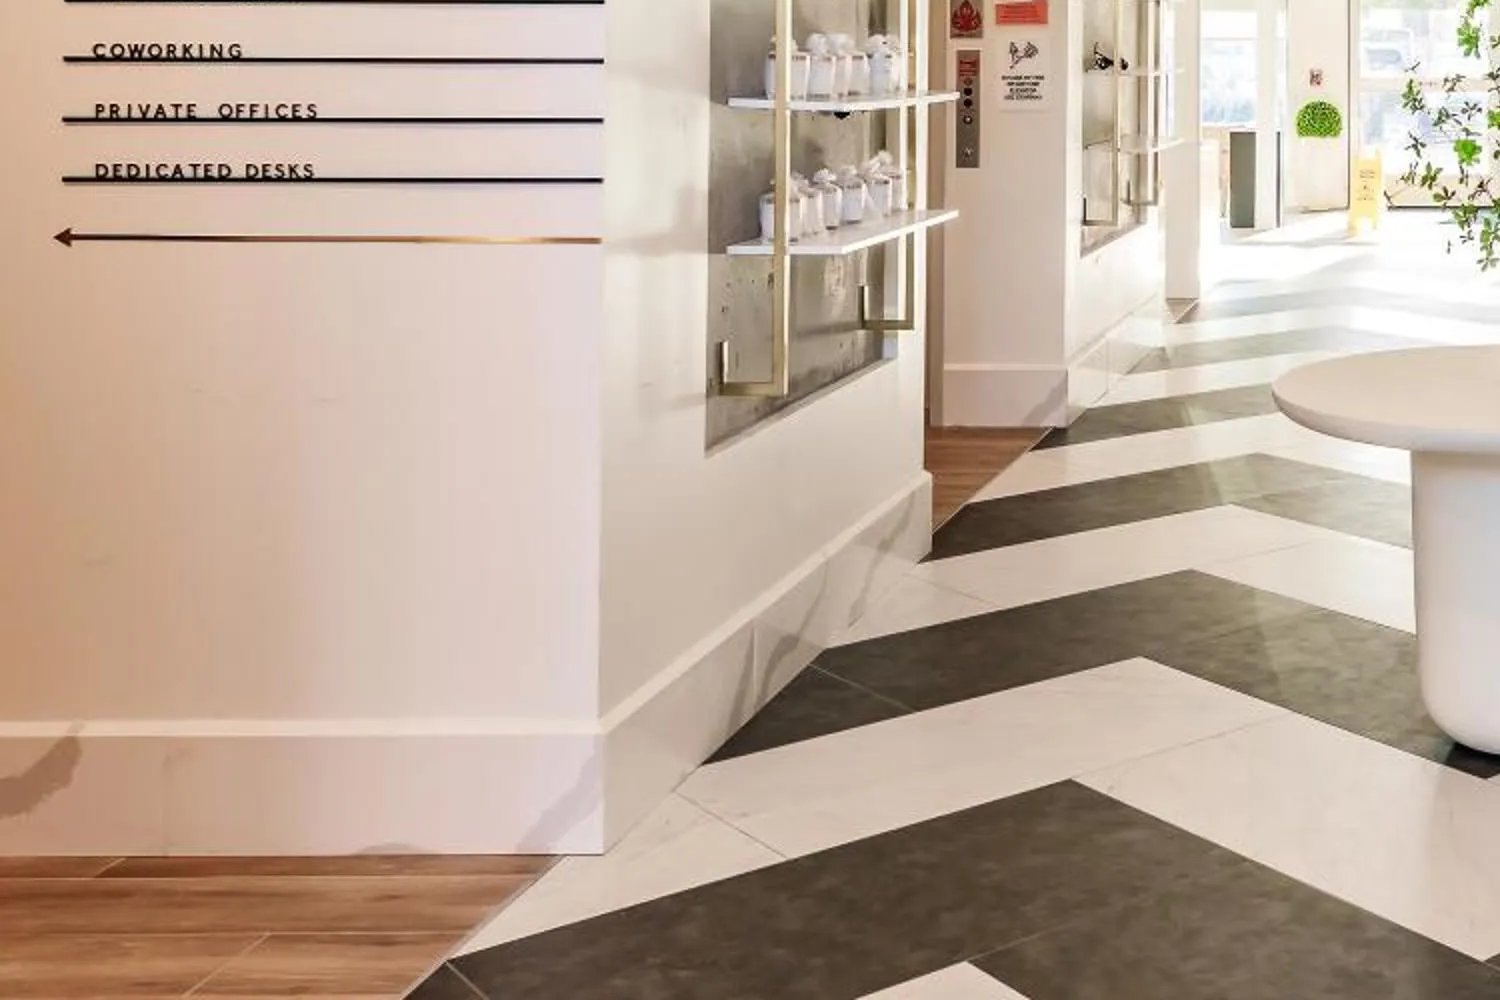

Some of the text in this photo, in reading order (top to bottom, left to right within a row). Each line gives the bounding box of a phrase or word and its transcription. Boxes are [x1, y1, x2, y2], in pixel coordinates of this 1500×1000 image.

[92, 43, 243, 59] COWORKING
[95, 103, 318, 119] PRIVATE OFFICES
[95, 163, 315, 179] DEDICATED DESKS
